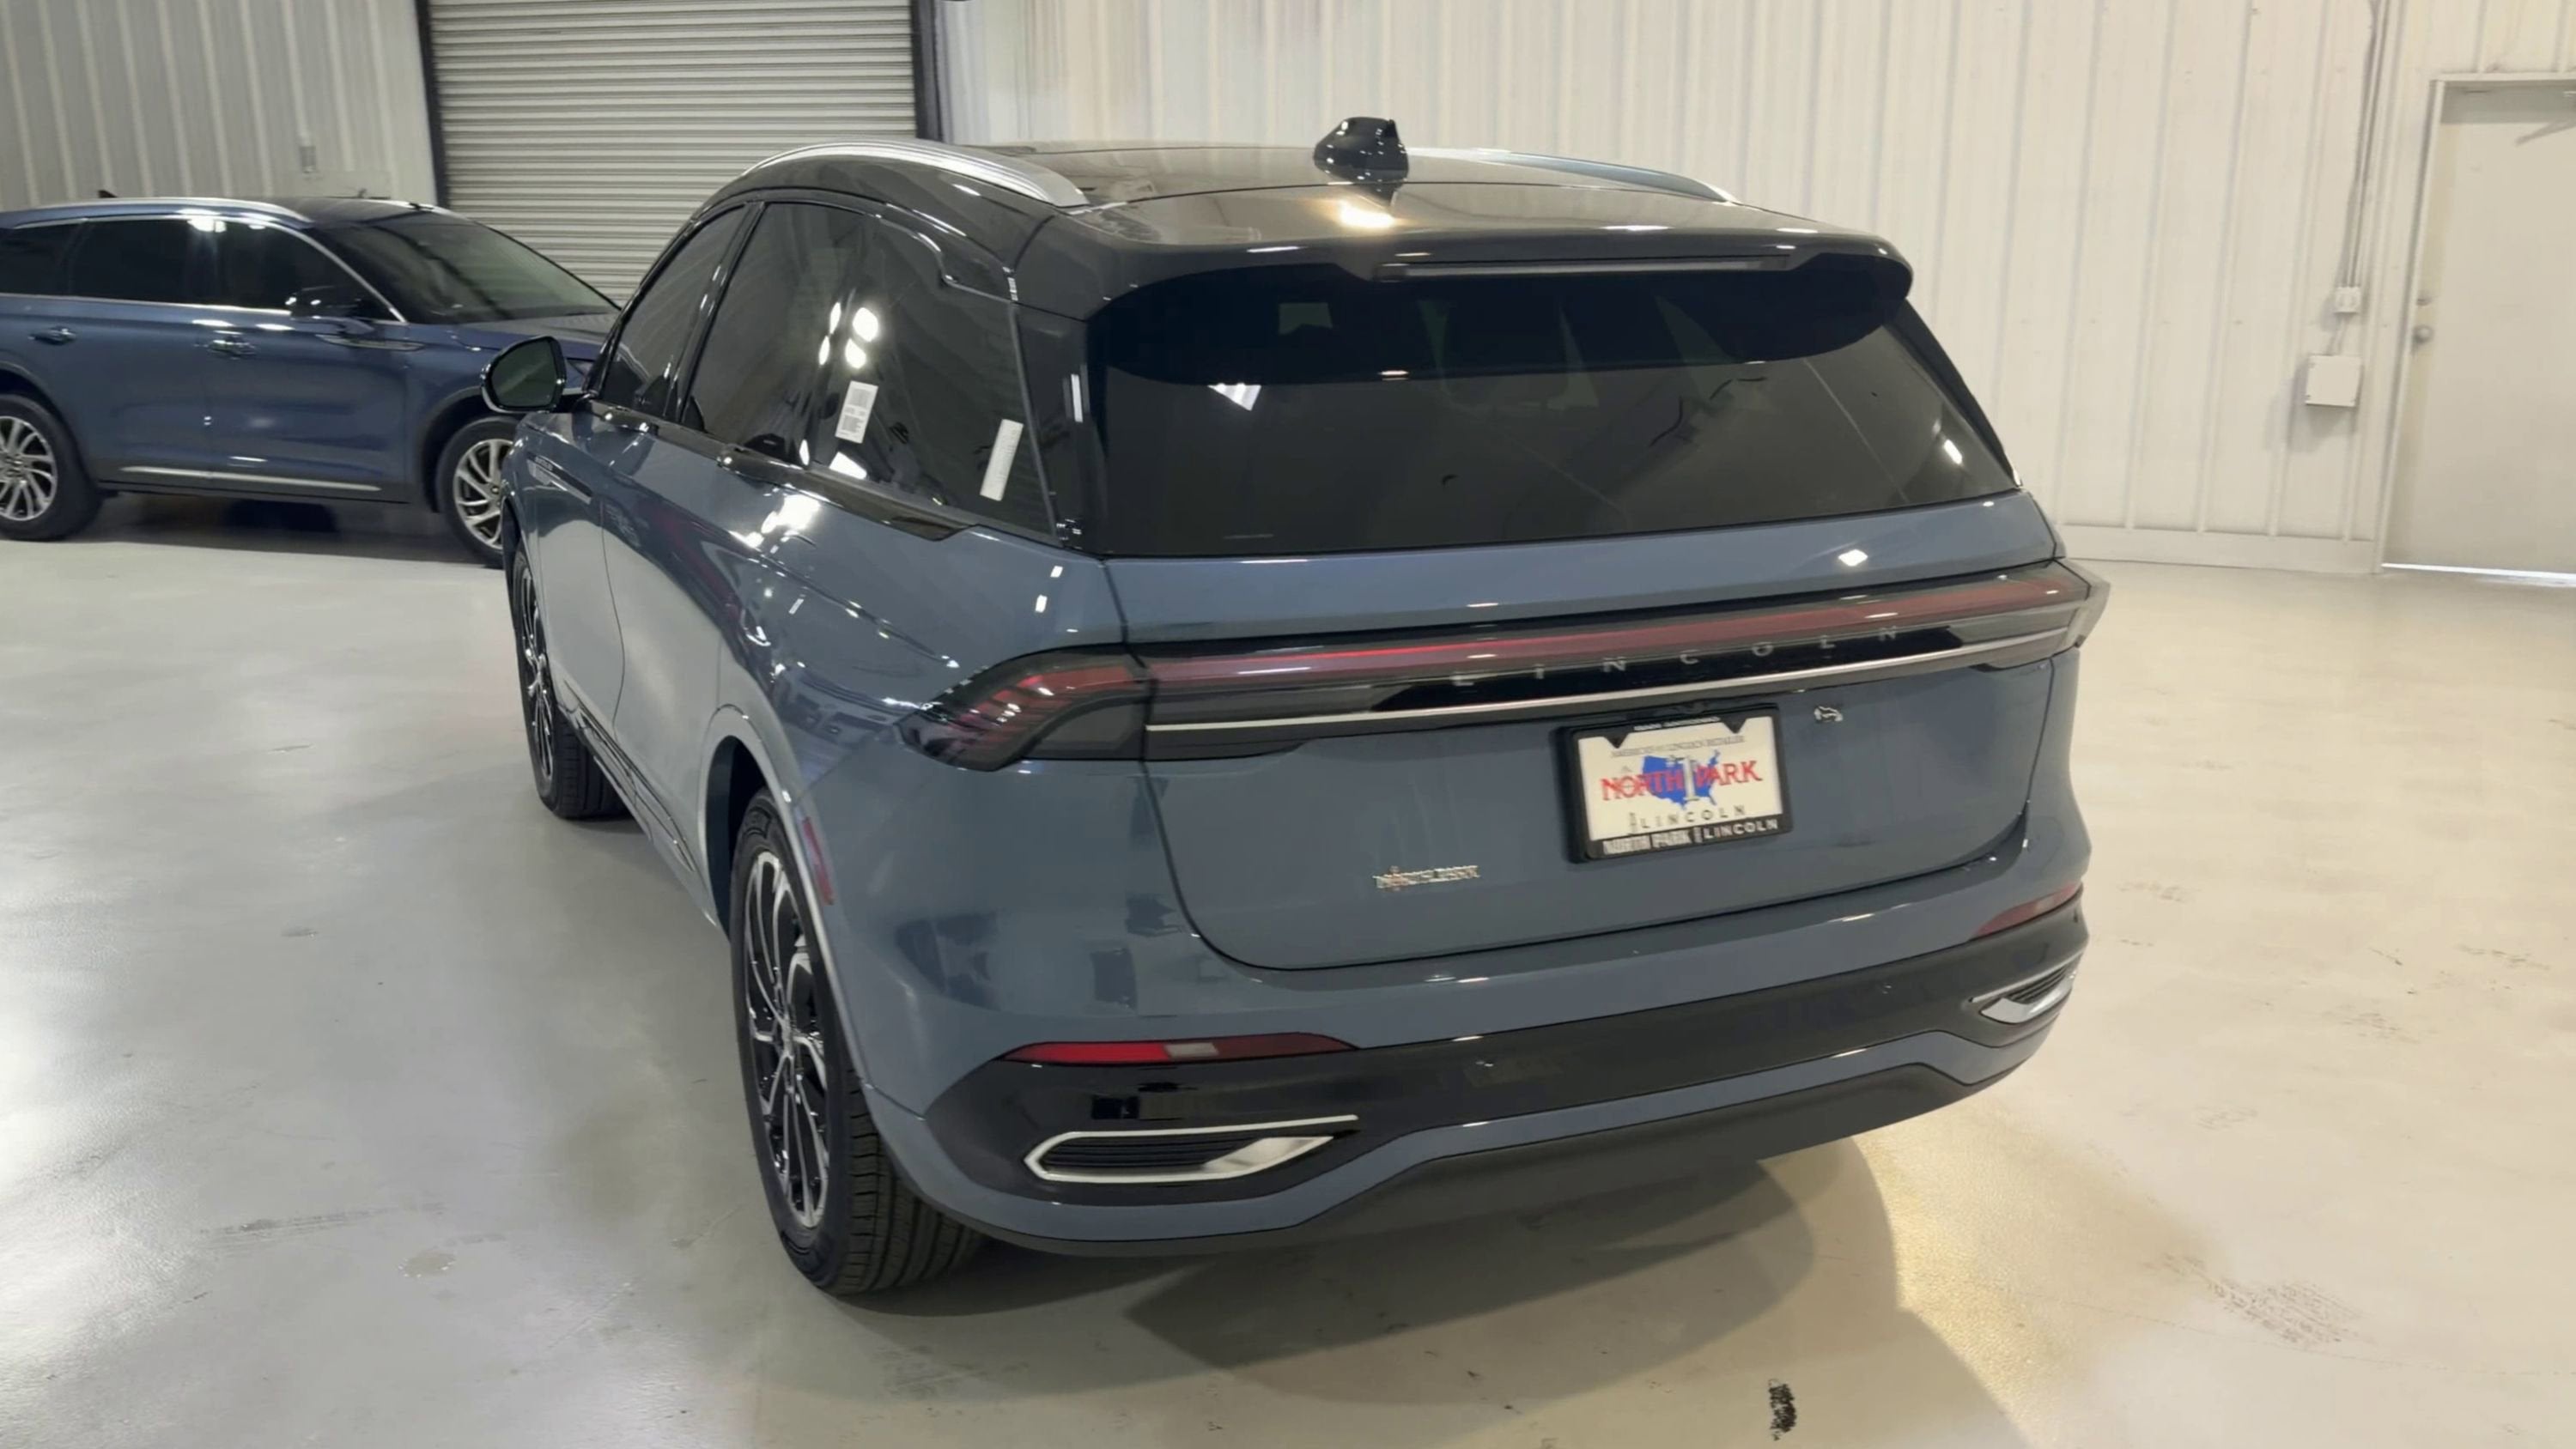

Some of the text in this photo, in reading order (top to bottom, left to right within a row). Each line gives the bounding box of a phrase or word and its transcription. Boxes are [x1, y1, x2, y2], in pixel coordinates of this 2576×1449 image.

[1450, 625, 1897, 687] LINCOLN
[1600, 768, 1684, 801] NORTH
[1696, 760, 1764, 787] PARK
[1640, 804, 1746, 829] LINCOLN
[1703, 818, 1779, 840] LINCOLN
